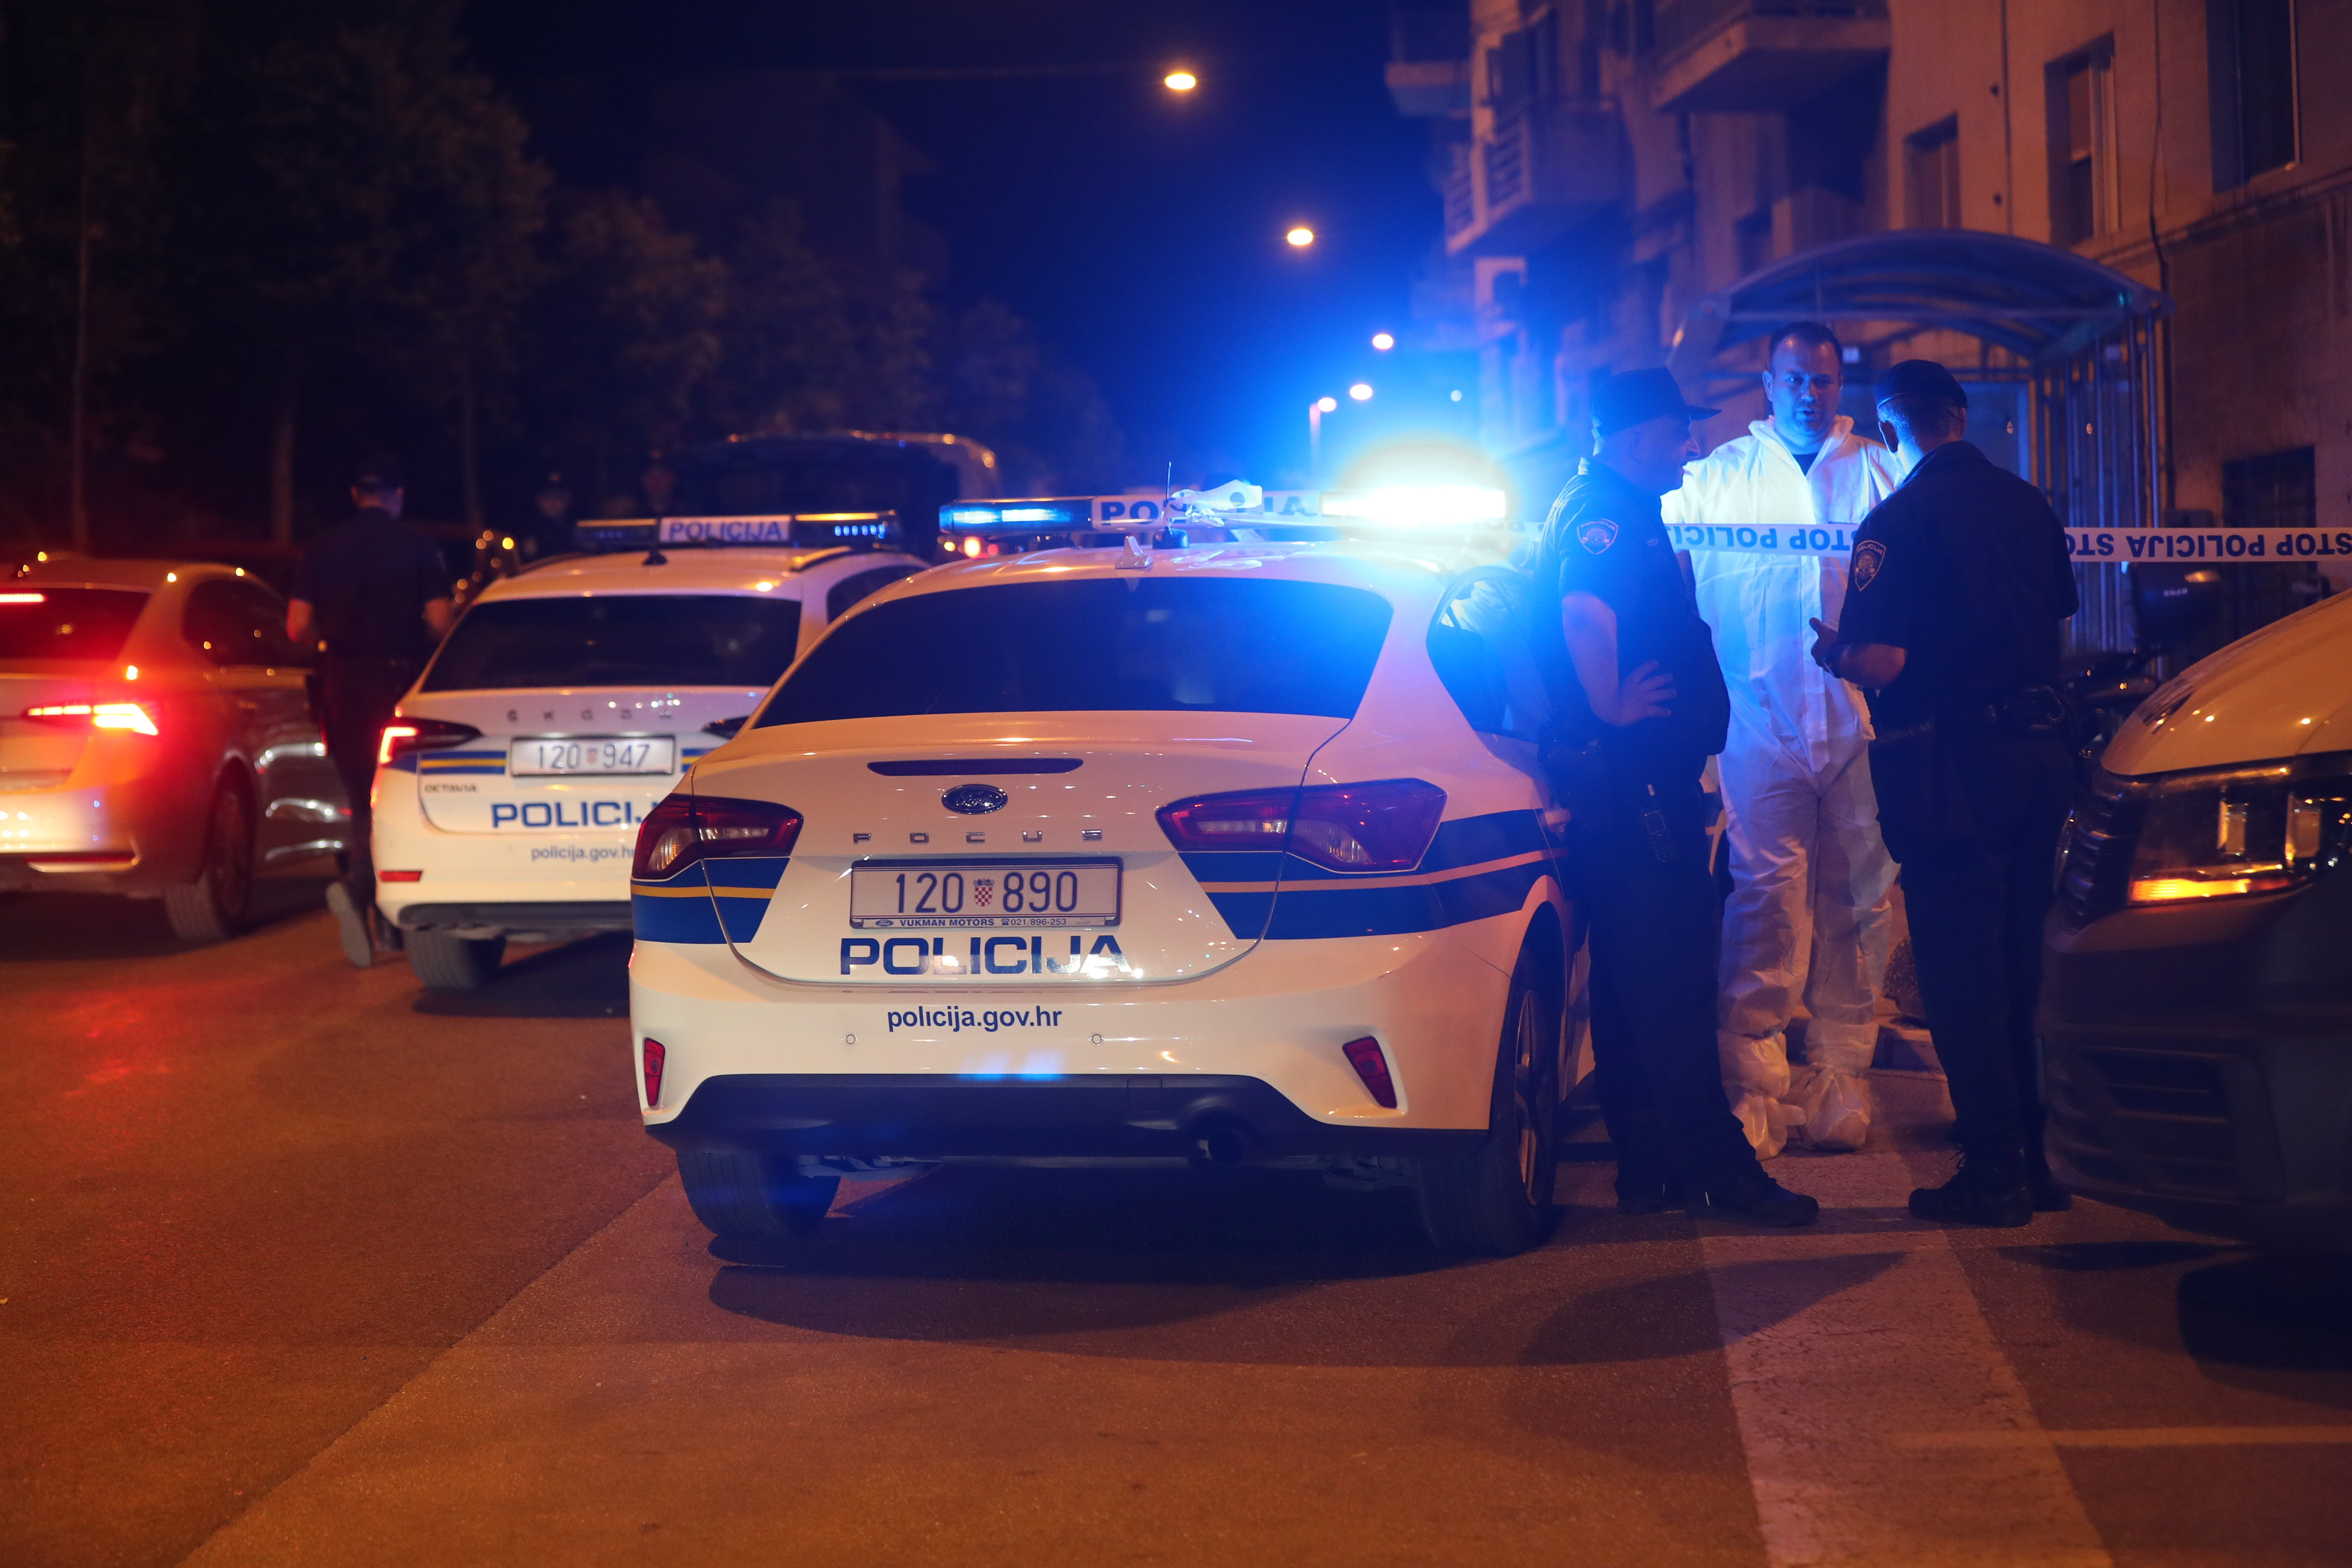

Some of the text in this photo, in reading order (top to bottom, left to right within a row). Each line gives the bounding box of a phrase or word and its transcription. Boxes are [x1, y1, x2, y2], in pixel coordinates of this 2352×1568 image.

[670, 521, 781, 540] POLICIJA
[1789, 529, 1855, 551] TOP
[2126, 534, 2265, 557] POLICIJA
[2276, 533, 2352, 555] STOP
[539, 742, 649, 769] 120 947
[853, 829, 1102, 843] FOCUS
[896, 871, 1078, 913] 120 890
[900, 919, 946, 927] VUKMAN
[949, 918, 995, 926] MOTORS
[840, 935, 1133, 975] POLICIJA
[888, 1006, 1062, 1032] policija.gov.hr
